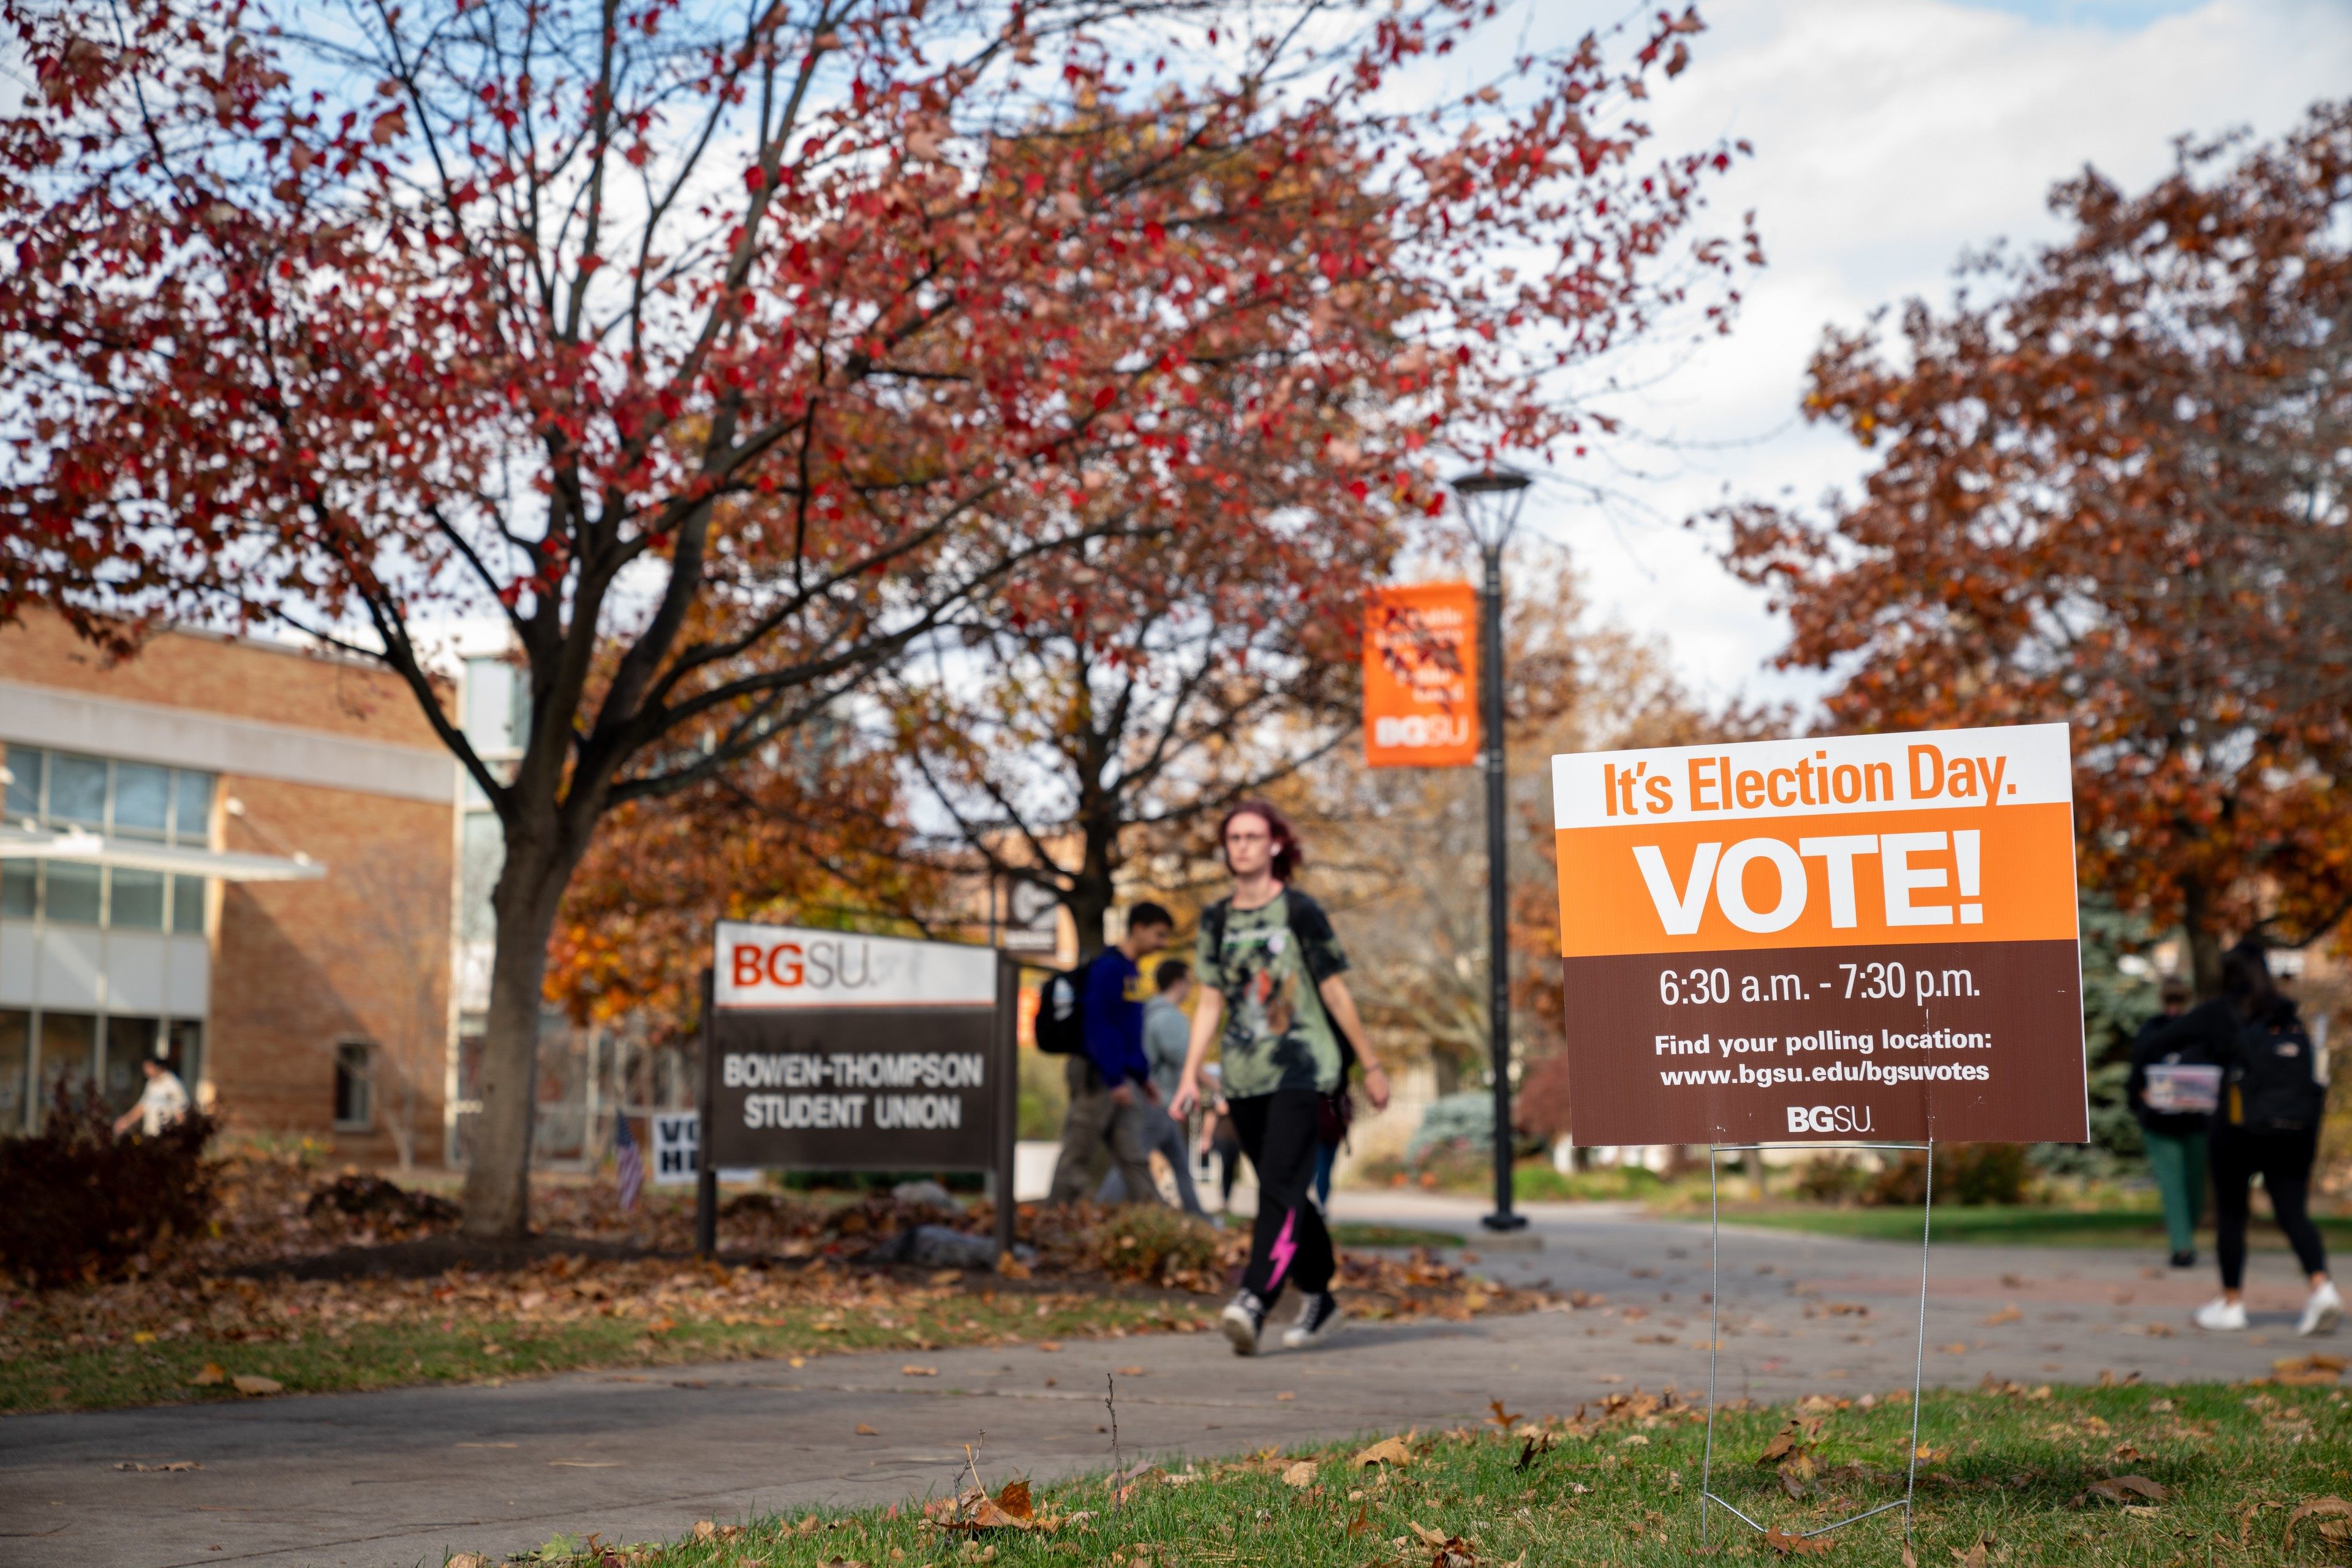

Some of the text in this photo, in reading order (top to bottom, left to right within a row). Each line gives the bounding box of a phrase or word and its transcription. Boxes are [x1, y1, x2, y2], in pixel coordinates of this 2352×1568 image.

[1604, 743, 2017, 816] It's Election Day.
[1632, 829, 1984, 935] VOTE!
[732, 941, 870, 989] BGSU
[1660, 968, 1730, 1006] 6:30
[1741, 974, 1810, 1003] a.m.
[1839, 962, 1906, 999] 7:30
[1915, 969, 1980, 1006] p.m.
[1655, 1028, 1992, 1058] Find your polling location:
[723, 1053, 983, 1087] BOWEN-THOMPSON
[1660, 1060, 1989, 1088] www.bgsu.edu/bgsuvotes
[744, 1094, 961, 1129] STUDENT UNION
[1787, 1105, 1871, 1133] BGSU
